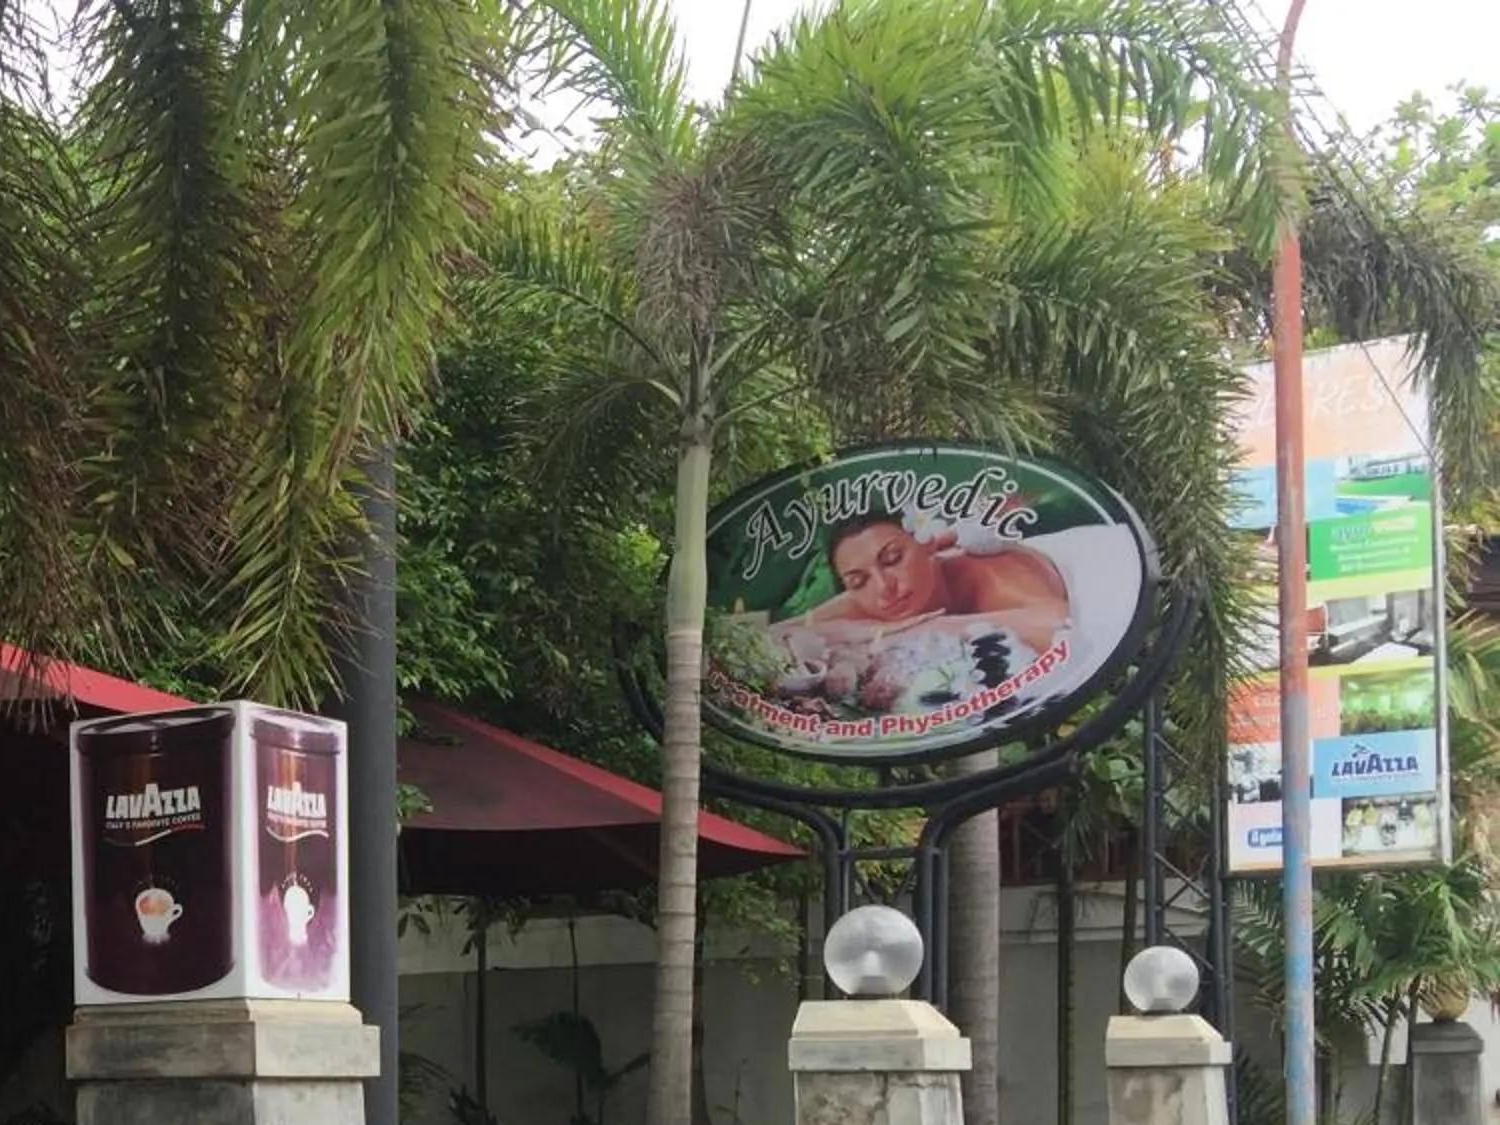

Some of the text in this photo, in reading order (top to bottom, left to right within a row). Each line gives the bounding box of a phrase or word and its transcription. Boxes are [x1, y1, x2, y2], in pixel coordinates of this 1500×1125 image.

[742, 467, 1038, 580] Ayurvedic
[825, 718, 874, 738] and
[881, 640, 1070, 736] Physiotherapy
[1331, 753, 1419, 777] LAVAZZA
[106, 783, 201, 819] LAVAZZA
[267, 781, 327, 817] LAVAZZA
